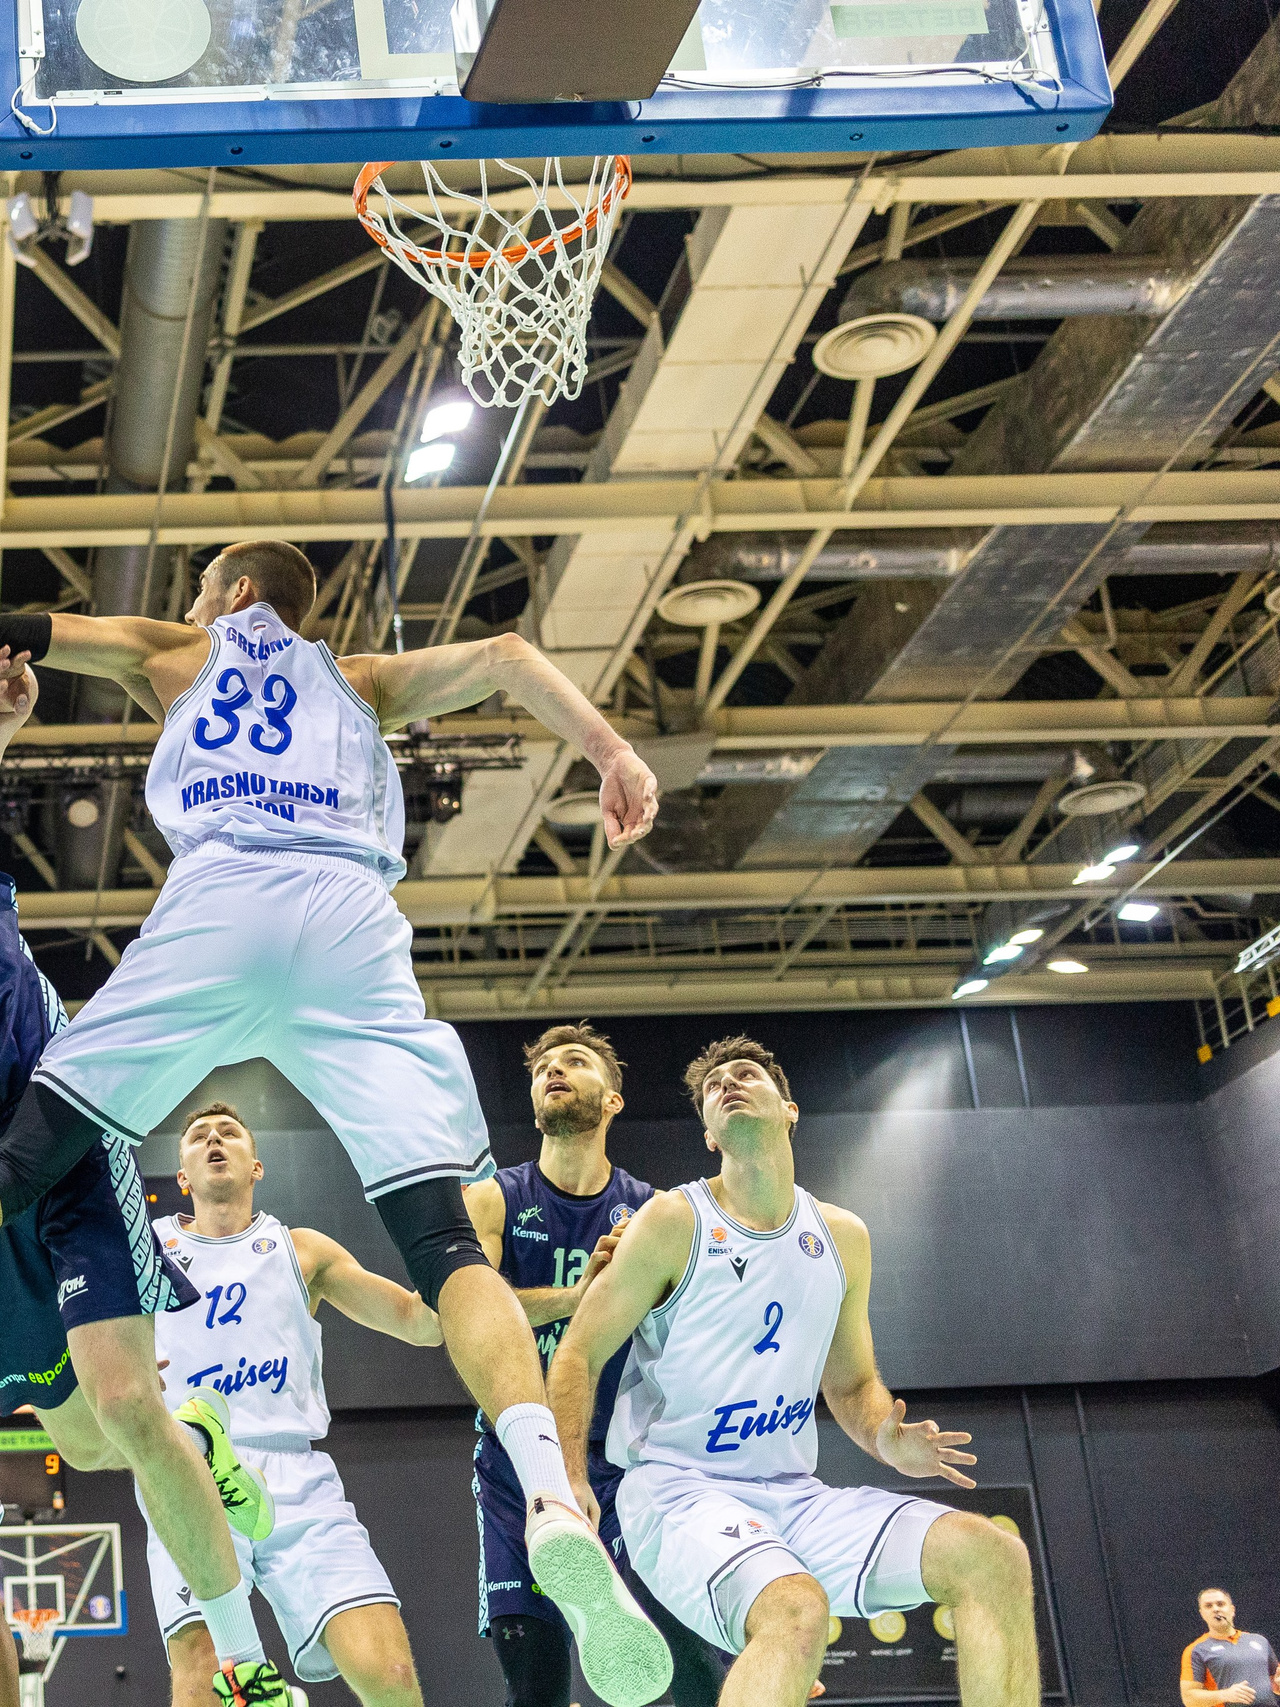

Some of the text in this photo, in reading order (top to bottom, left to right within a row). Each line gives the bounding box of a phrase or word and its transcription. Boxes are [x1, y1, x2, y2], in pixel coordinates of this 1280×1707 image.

[193, 667, 297, 756] 33
[512, 1225, 549, 1242] Kempa
[707, 1246, 734, 1255] ENISEY
[552, 1247, 590, 1289] 12
[205, 1282, 248, 1330] 12
[753, 1301, 783, 1355] 2
[705, 1394, 814, 1454] Enisey
[45, 1453, 60, 1475] 9
[487, 1580, 522, 1592] Kempa
